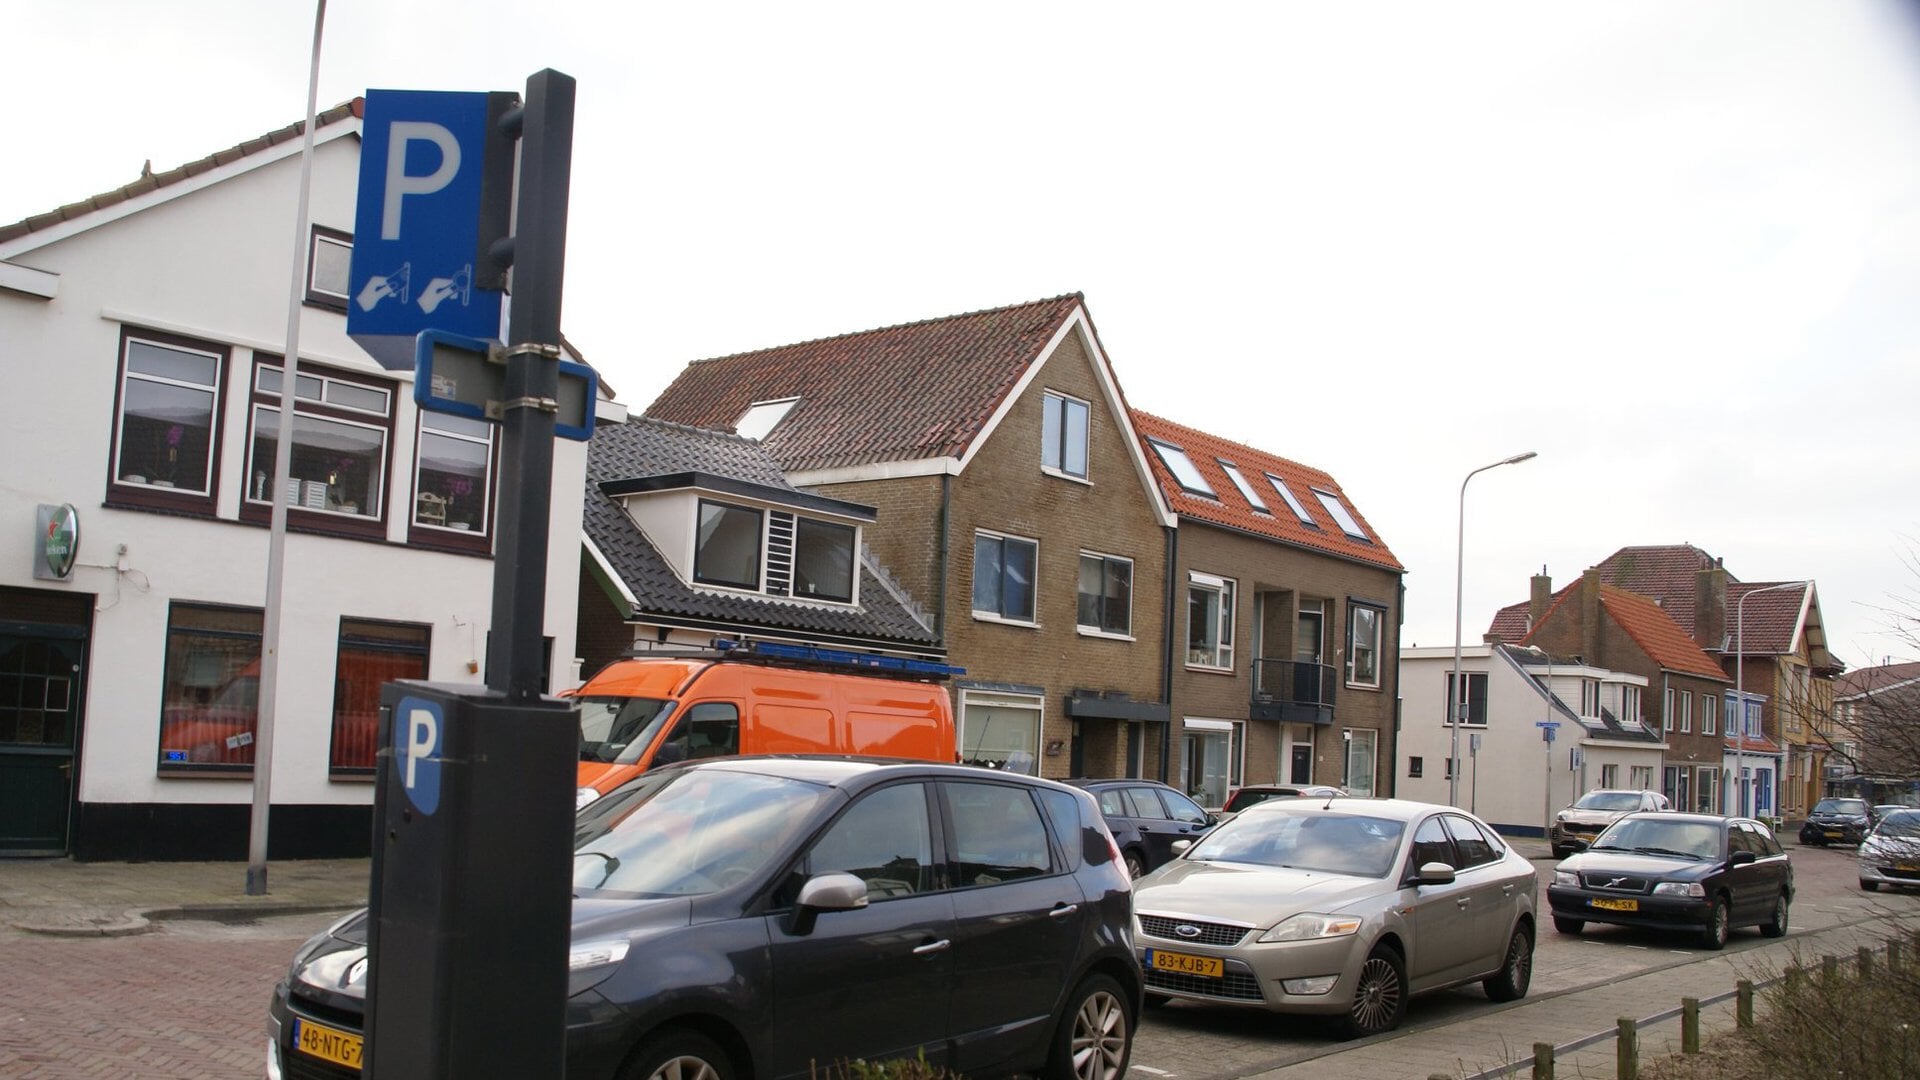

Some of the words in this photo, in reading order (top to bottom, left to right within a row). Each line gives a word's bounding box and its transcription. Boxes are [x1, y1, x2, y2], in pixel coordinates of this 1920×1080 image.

[381, 121, 461, 241] P
[406, 709, 437, 789] P
[1158, 954, 1217, 973] 83-KJB-7
[303, 1027, 364, 1065] 48-NTG-7
